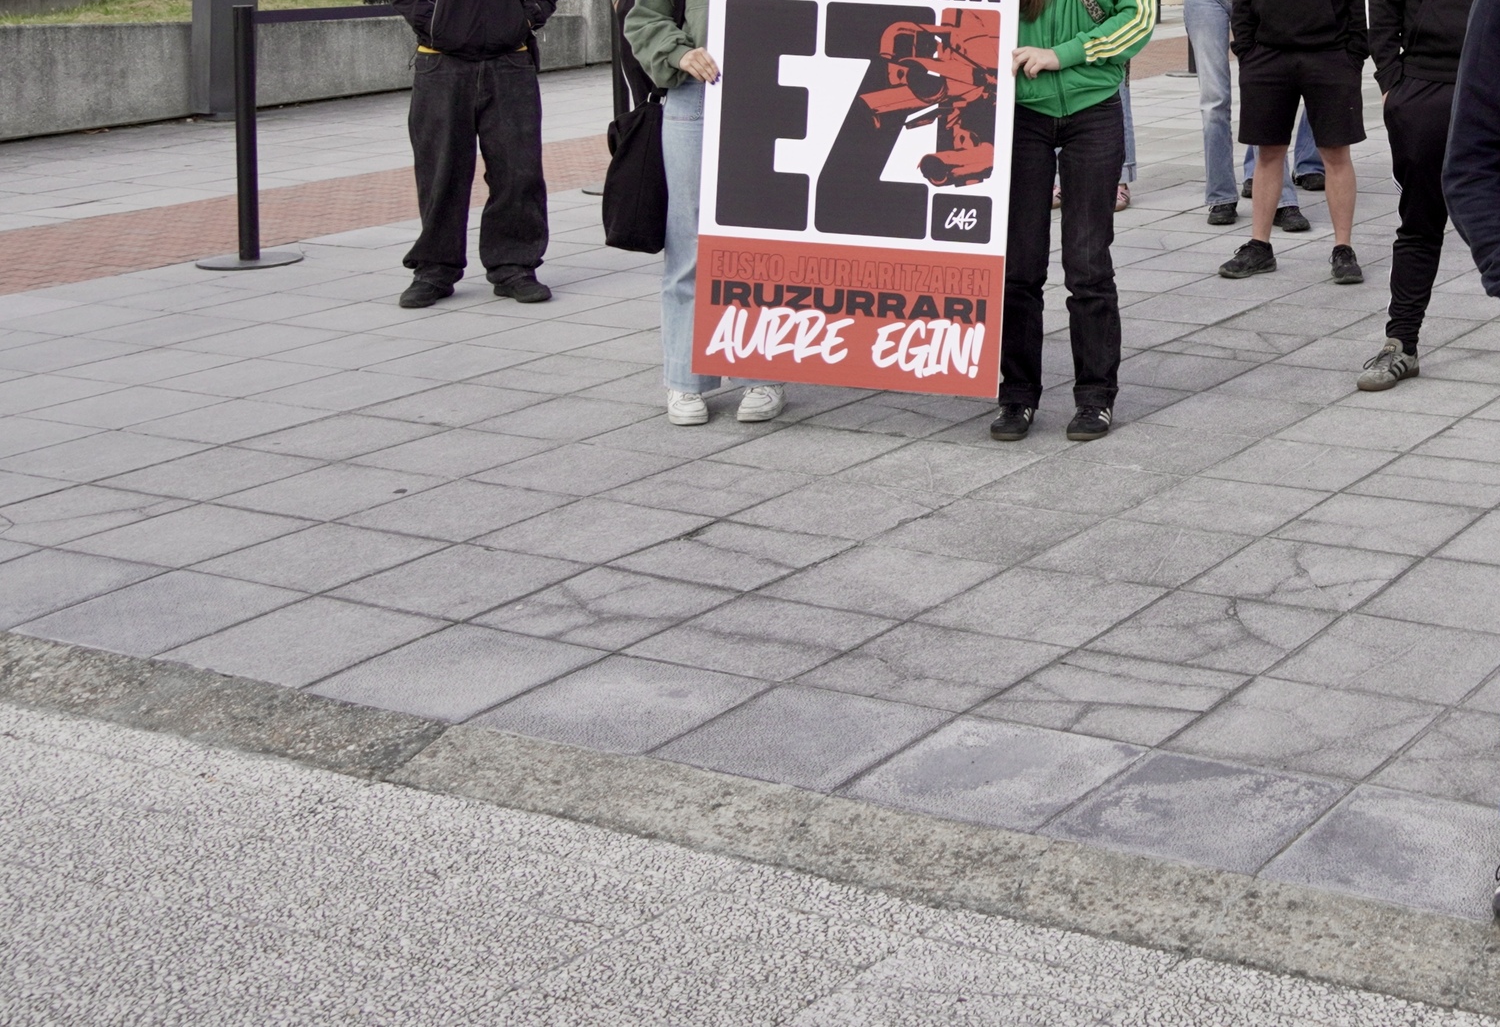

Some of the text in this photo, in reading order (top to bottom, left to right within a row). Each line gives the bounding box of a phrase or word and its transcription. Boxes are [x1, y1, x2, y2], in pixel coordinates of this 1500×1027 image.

[710, 249, 991, 297] EUSKO JAURLARITZAREN
[710, 279, 988, 325] IRUZURRARI
[705, 305, 986, 379] AURRE EGIN!
